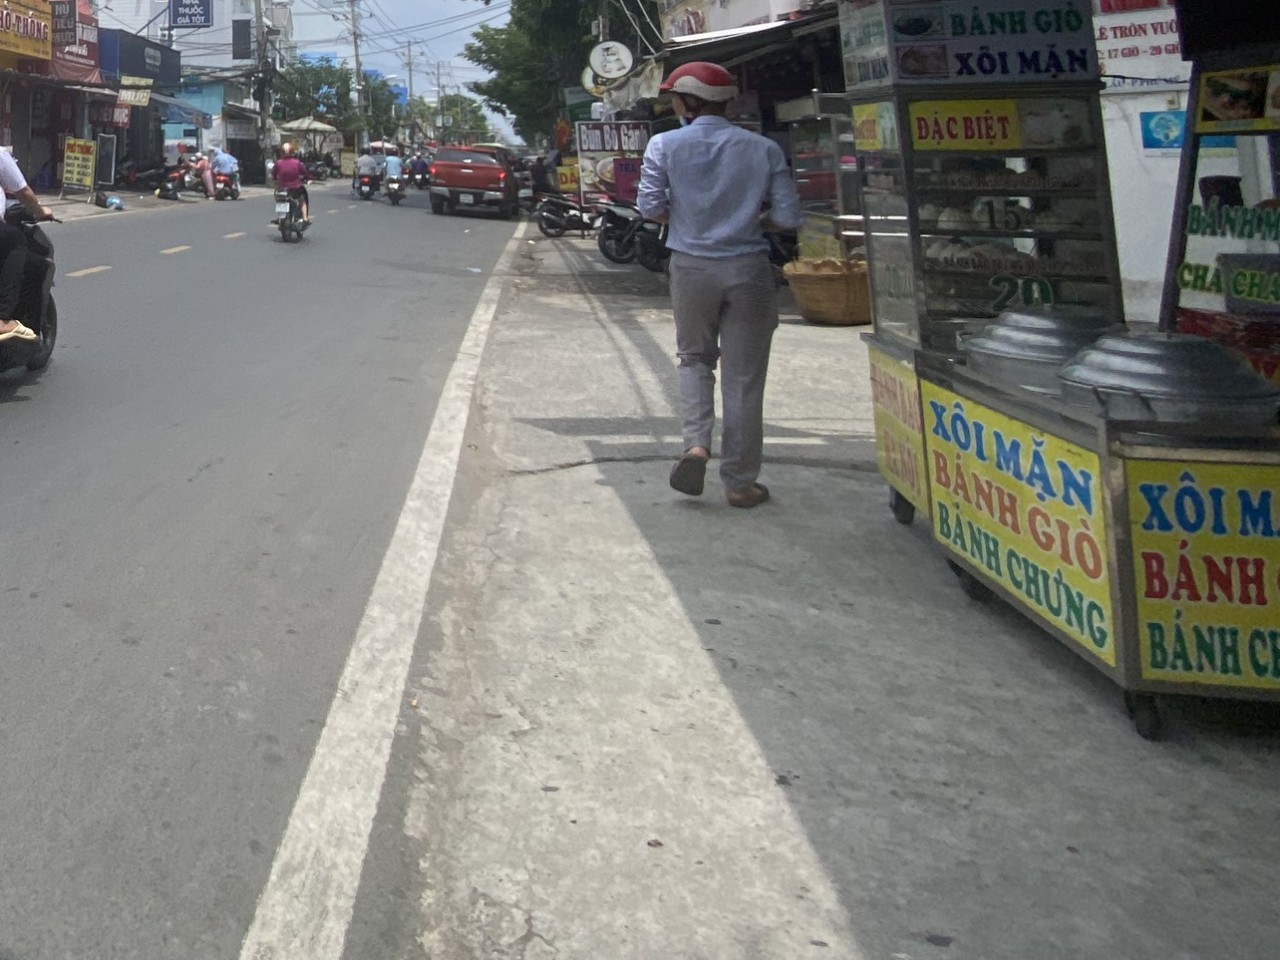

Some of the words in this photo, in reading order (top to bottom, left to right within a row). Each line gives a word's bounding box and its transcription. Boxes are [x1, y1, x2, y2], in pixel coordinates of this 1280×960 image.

[950, 6, 1027, 36] BÁNH
[954, 45, 1010, 76] XÔI
[1017, 43, 1090, 79] MẶN
[962, 109, 1011, 146] BIỆT
[929, 400, 987, 461] XÔI
[993, 431, 1093, 516] MẶN
[932, 449, 1021, 535] BÁNH
[1027, 506, 1103, 580] GIÒ
[1138, 471, 1228, 535] XÔI
[937, 500, 1003, 578] BÁNH
[1006, 548, 1108, 649] CHƯNG
[1141, 539, 1268, 606] BÁNH
[1147, 608, 1242, 676] BÁNH
